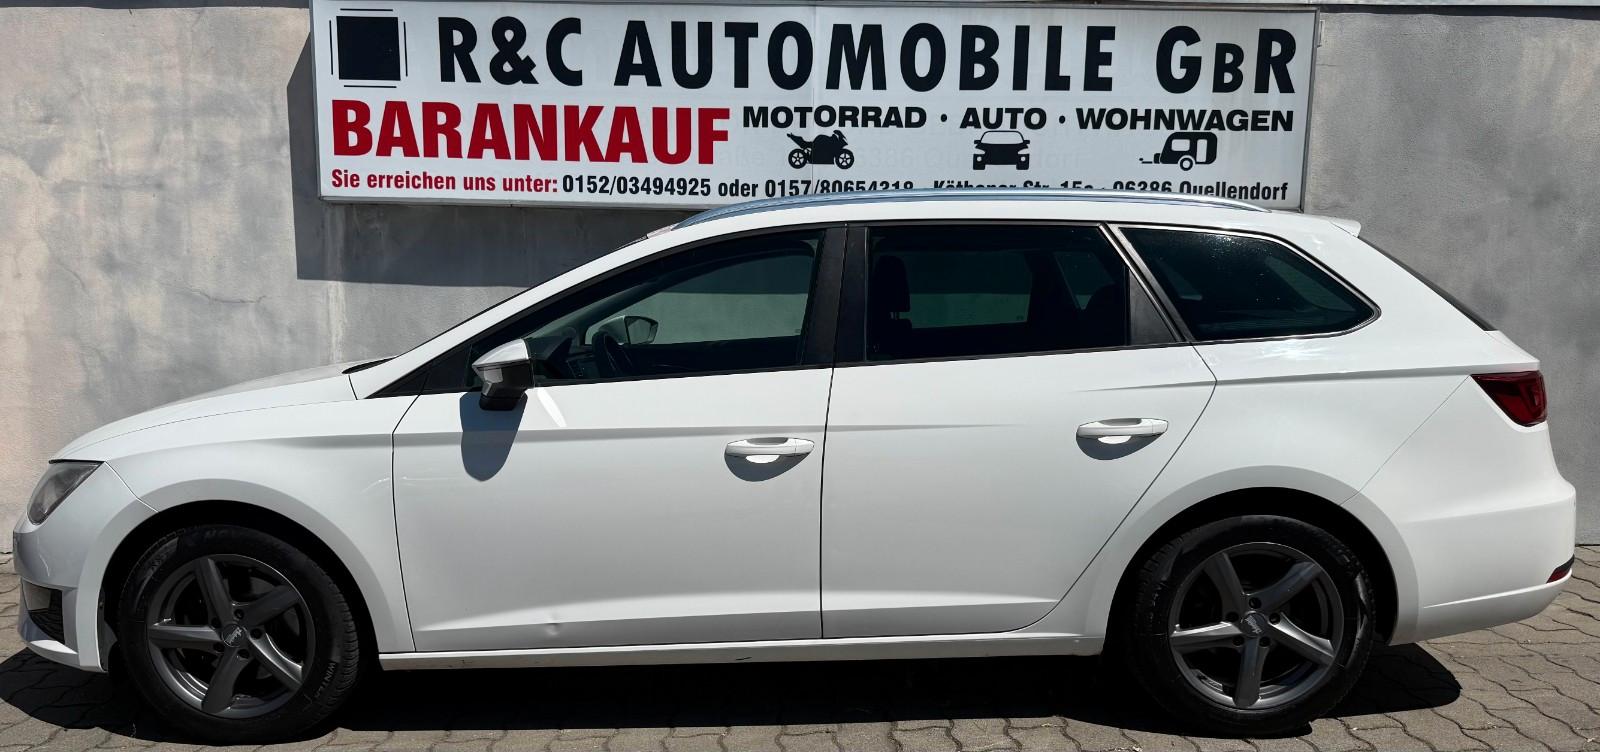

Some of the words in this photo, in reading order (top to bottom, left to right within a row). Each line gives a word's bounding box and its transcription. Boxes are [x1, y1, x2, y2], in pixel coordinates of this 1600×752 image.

[437, 15, 583, 87] R&C
[613, 20, 1116, 93] AUTOMOBILE
[331, 99, 732, 165] BARANKAUF
[742, 105, 927, 129] MOTORRAD
[959, 107, 1047, 131] AUTO
[1075, 107, 1294, 132] WOHNWAGEN
[331, 168, 360, 188] Sie
[366, 170, 456, 190] erreichen
[463, 176, 496, 192] uns
[502, 174, 558, 193] unter:
[562, 174, 711, 197] 0152/03494925
[717, 178, 759, 198] oder
[1179, 180, 1289, 201] Quellendorf
